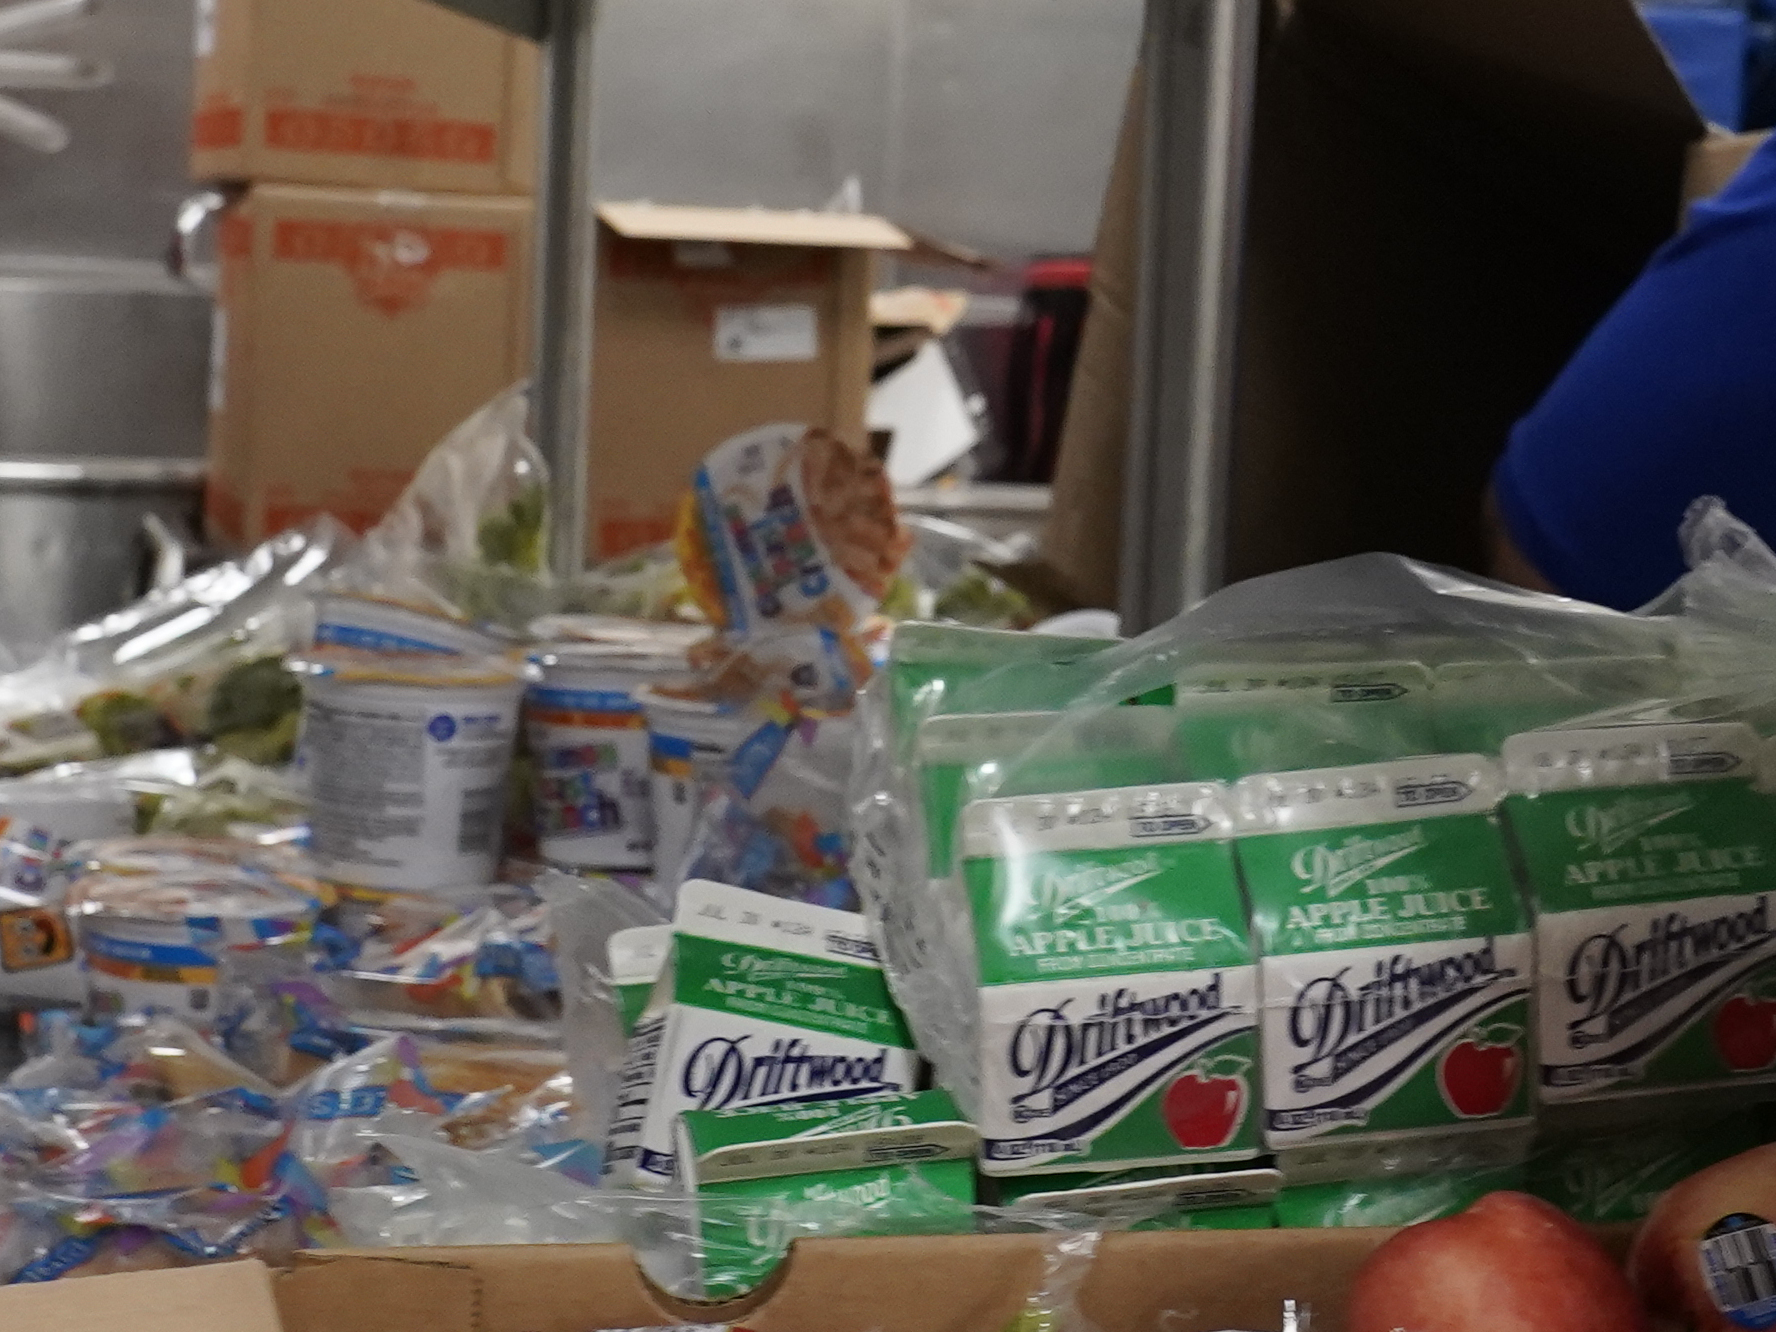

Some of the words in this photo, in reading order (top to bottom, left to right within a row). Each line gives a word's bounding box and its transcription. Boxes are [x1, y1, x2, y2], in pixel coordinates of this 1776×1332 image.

[1564, 854, 1665, 885] APPLE
[1672, 845, 1765, 874] JUICE
[1008, 926, 1119, 957] APPLE
[1130, 918, 1224, 946] JUICE
[1284, 896, 1390, 930] APPLE
[1397, 887, 1493, 918] JUICE
[1565, 895, 1771, 1030] Driftwood
[1010, 972, 1223, 1104] Driftwood
[1289, 936, 1497, 1075] Driftwood
[682, 1034, 892, 1111] Driftwood
